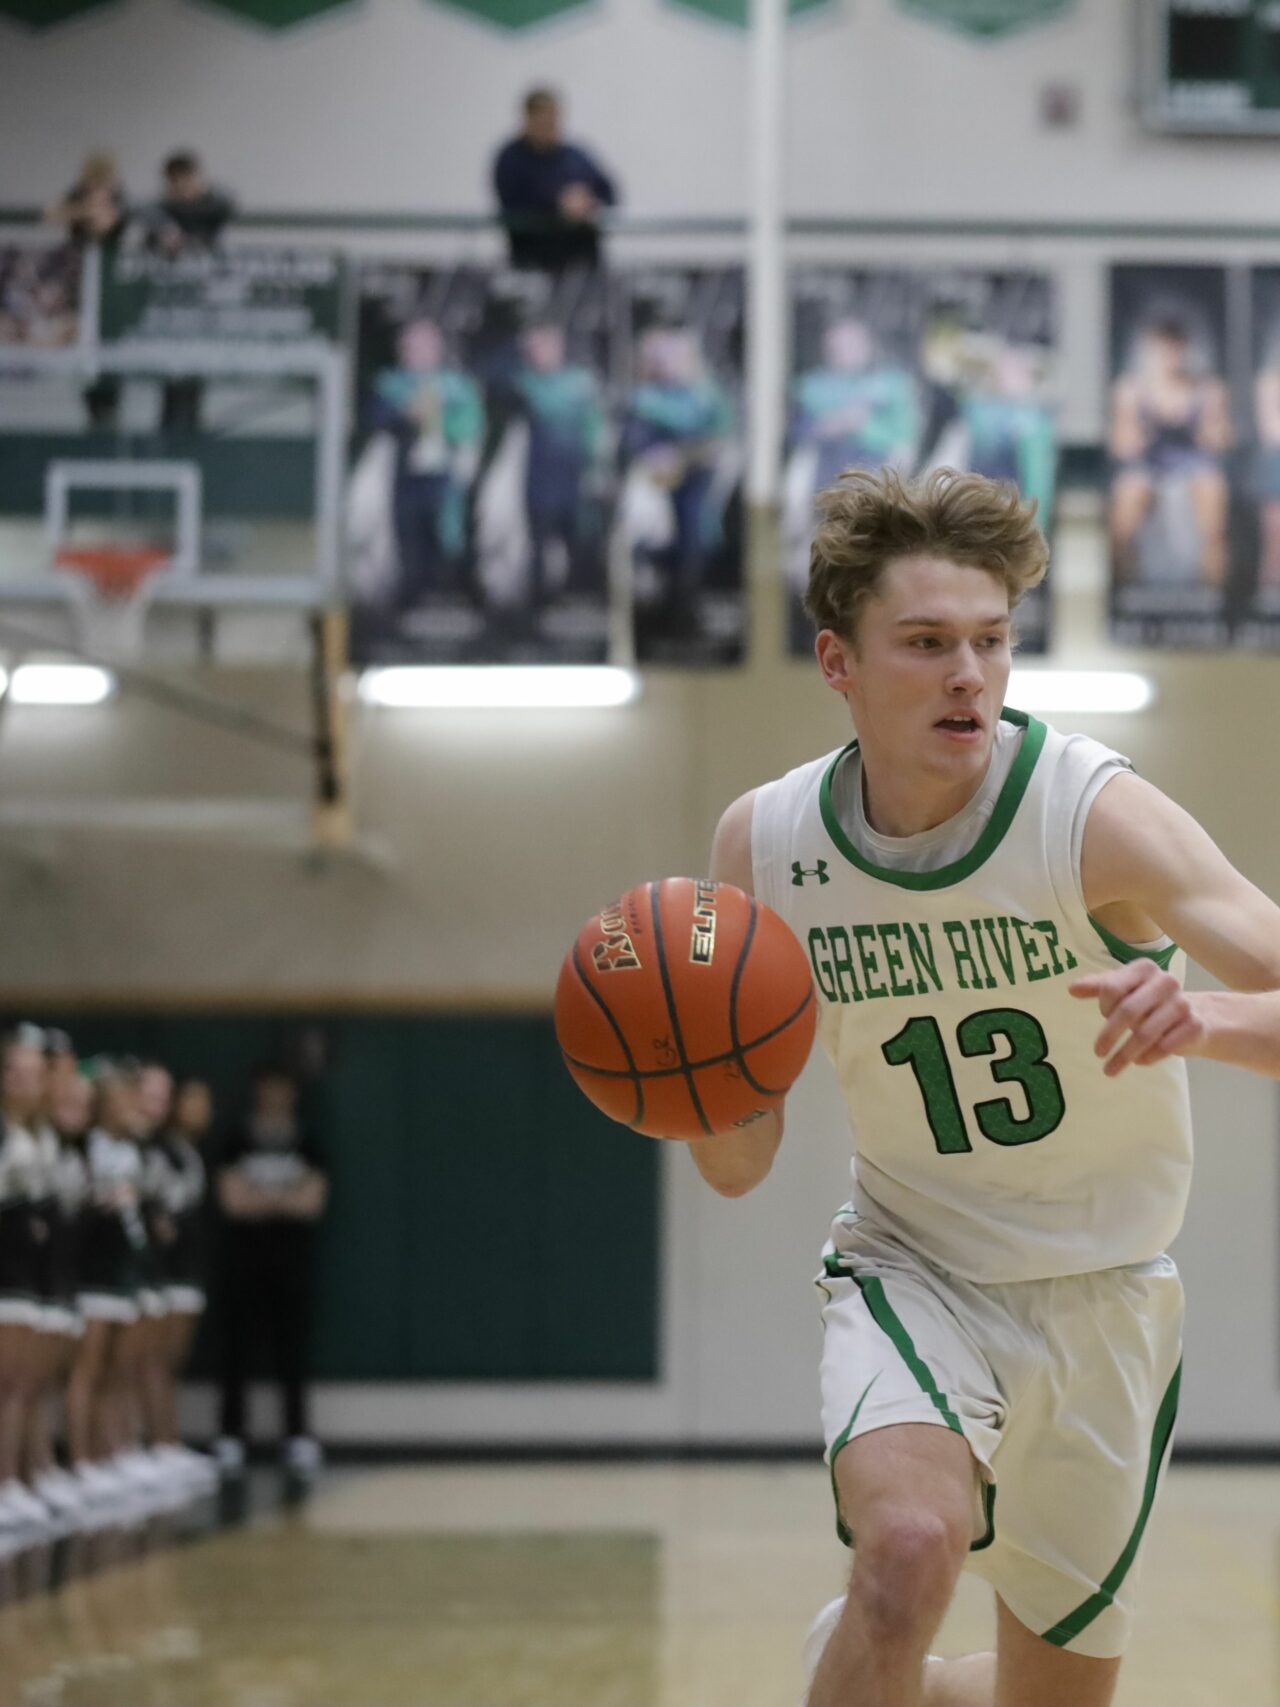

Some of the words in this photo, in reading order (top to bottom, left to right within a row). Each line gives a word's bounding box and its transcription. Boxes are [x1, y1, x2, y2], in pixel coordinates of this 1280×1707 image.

[689, 878, 717, 965] ELITE
[808, 922, 943, 1003] GREEN
[942, 916, 1078, 989] RIVER
[881, 1007, 1066, 1154] 13
